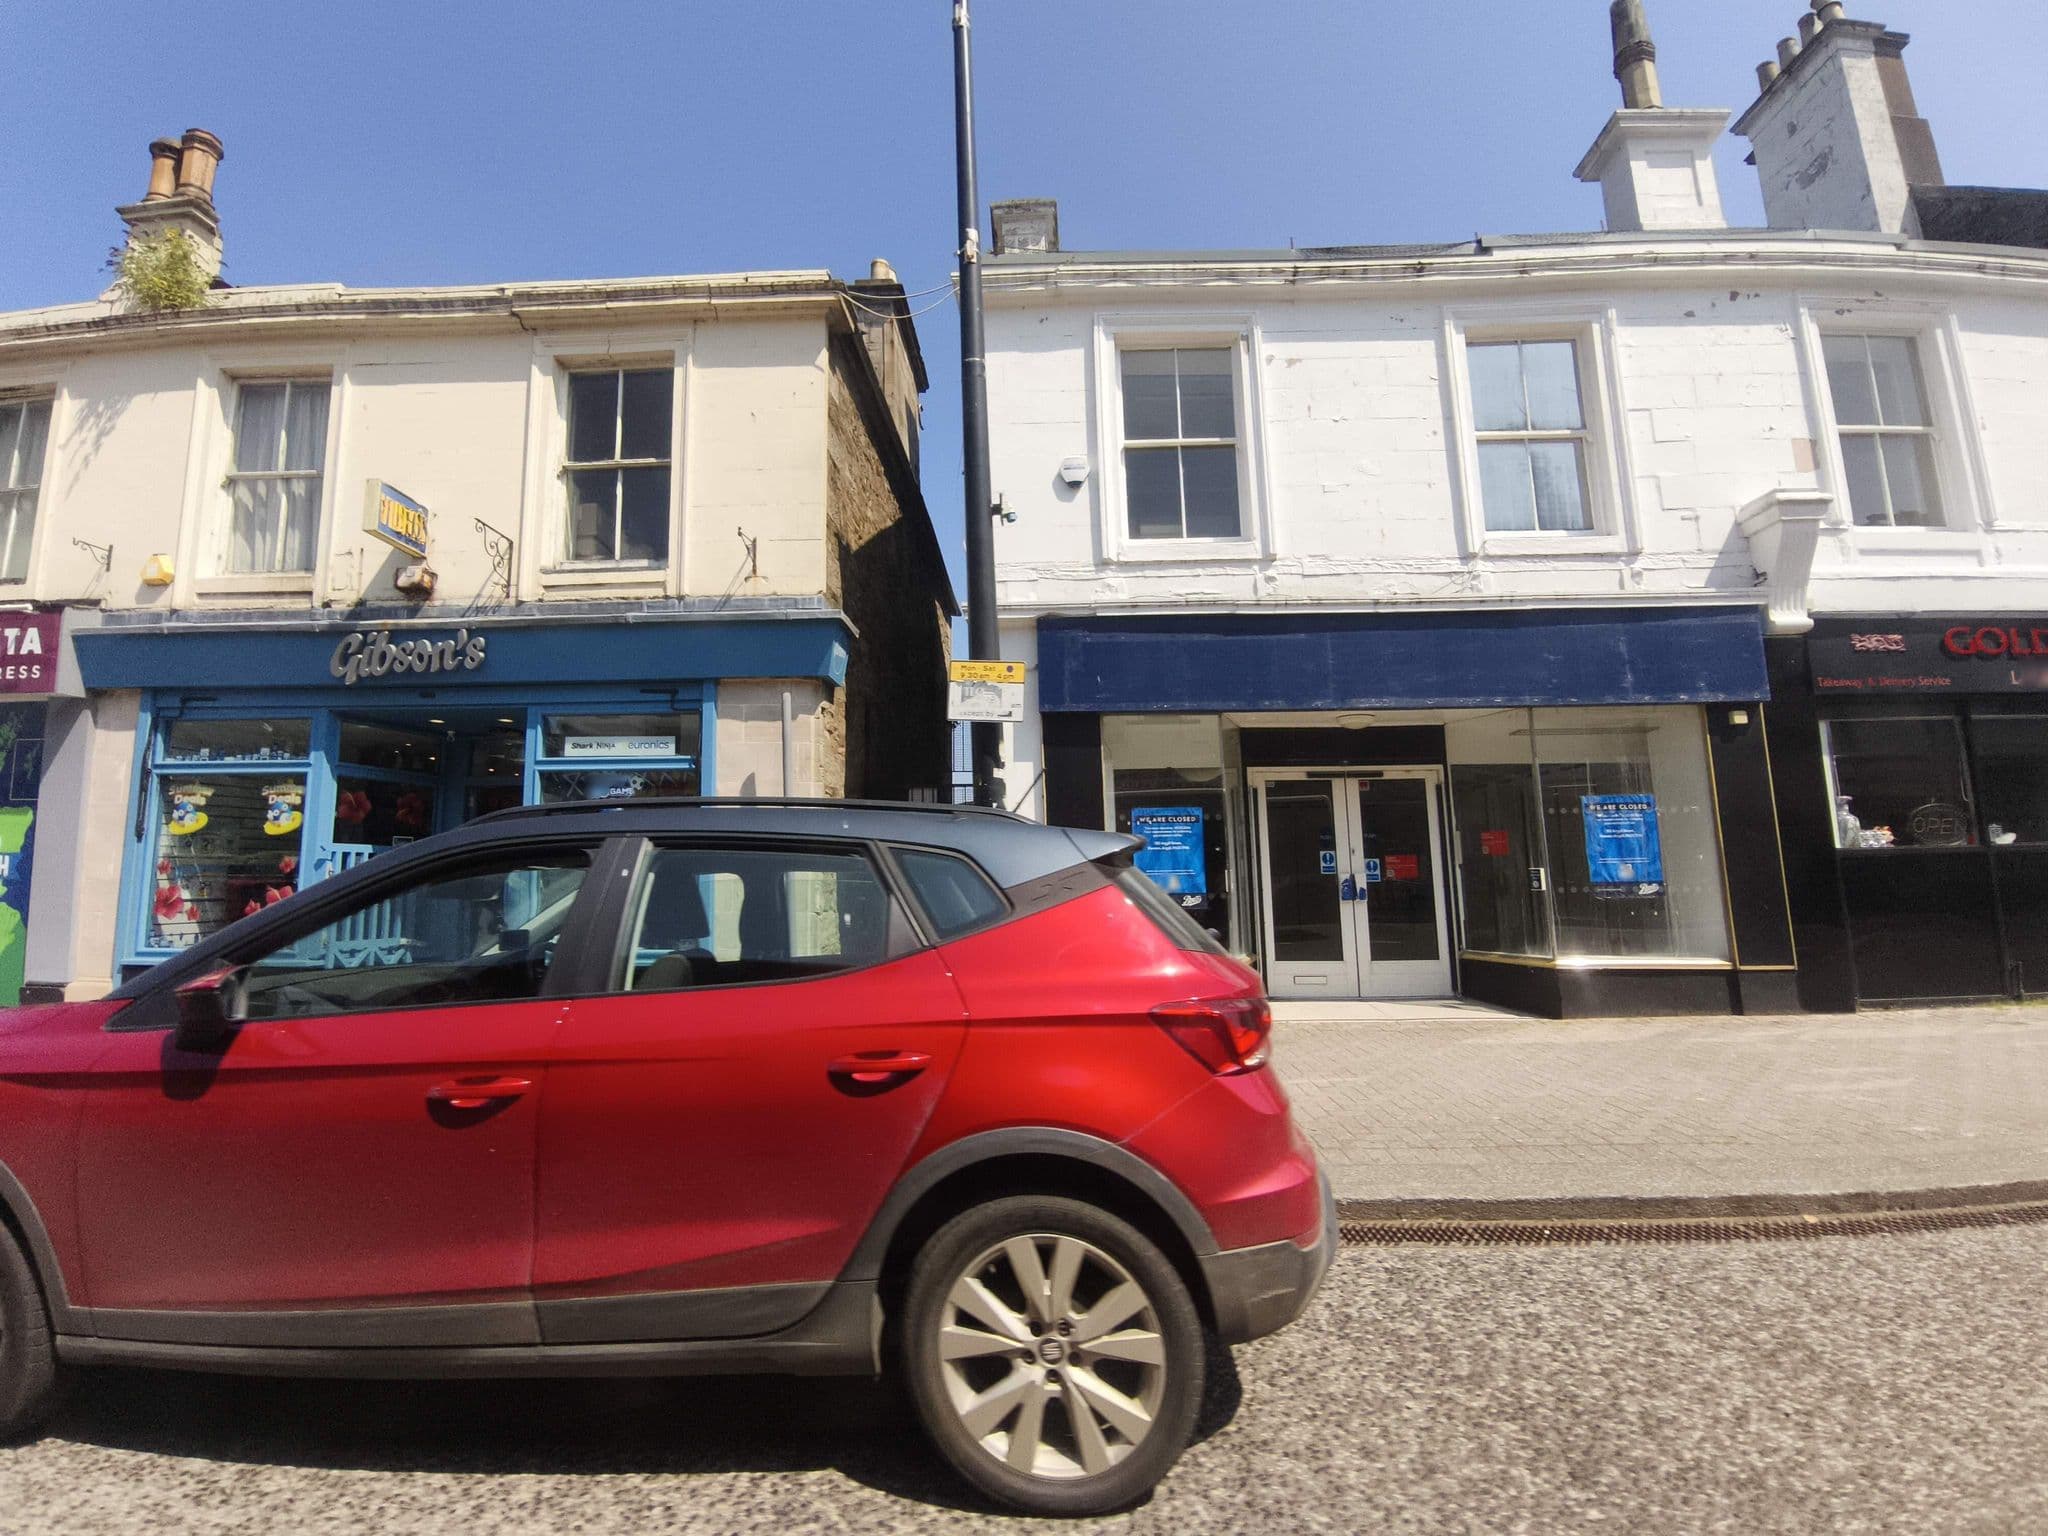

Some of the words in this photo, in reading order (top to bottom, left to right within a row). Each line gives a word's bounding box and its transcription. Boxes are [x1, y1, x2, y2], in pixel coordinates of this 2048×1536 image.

[0, 627, 42, 655] TA
[330, 628, 485, 685] Gibson's
[0, 665, 41, 679] ESS
[1816, 676, 1864, 689] Takeaway
[1919, 676, 1951, 687] Service
[571, 742, 593, 750] Shark
[628, 740, 670, 750] euronics
